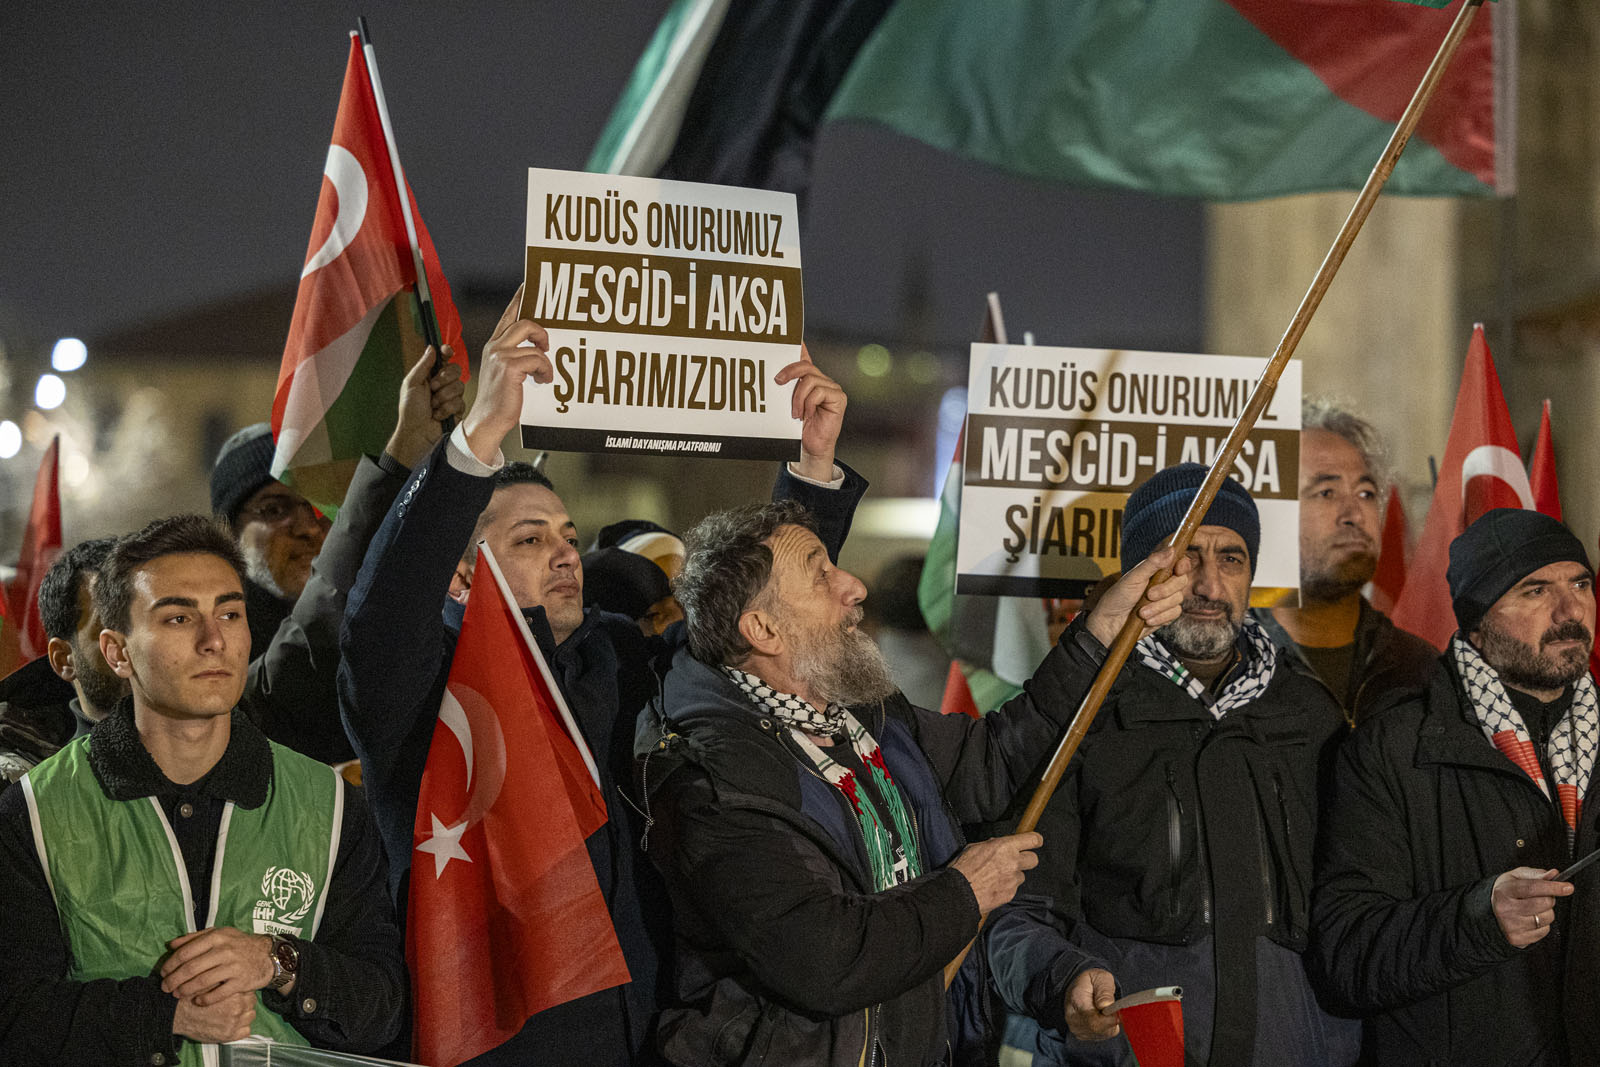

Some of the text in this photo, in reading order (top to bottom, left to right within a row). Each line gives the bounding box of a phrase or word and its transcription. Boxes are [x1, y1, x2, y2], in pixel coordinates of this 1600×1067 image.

[545, 190, 784, 258] KUDÜS ONURUMUZ
[534, 258, 787, 336] MESCİD-İ AKSA
[553, 338, 766, 413] ŞİARIMIZDIR!
[989, 362, 1098, 413] KUDÜS
[605, 435, 722, 453] İSLAMİ DAYANIŞMA PLATFORMU
[980, 422, 1167, 487] MESCİD-İ
